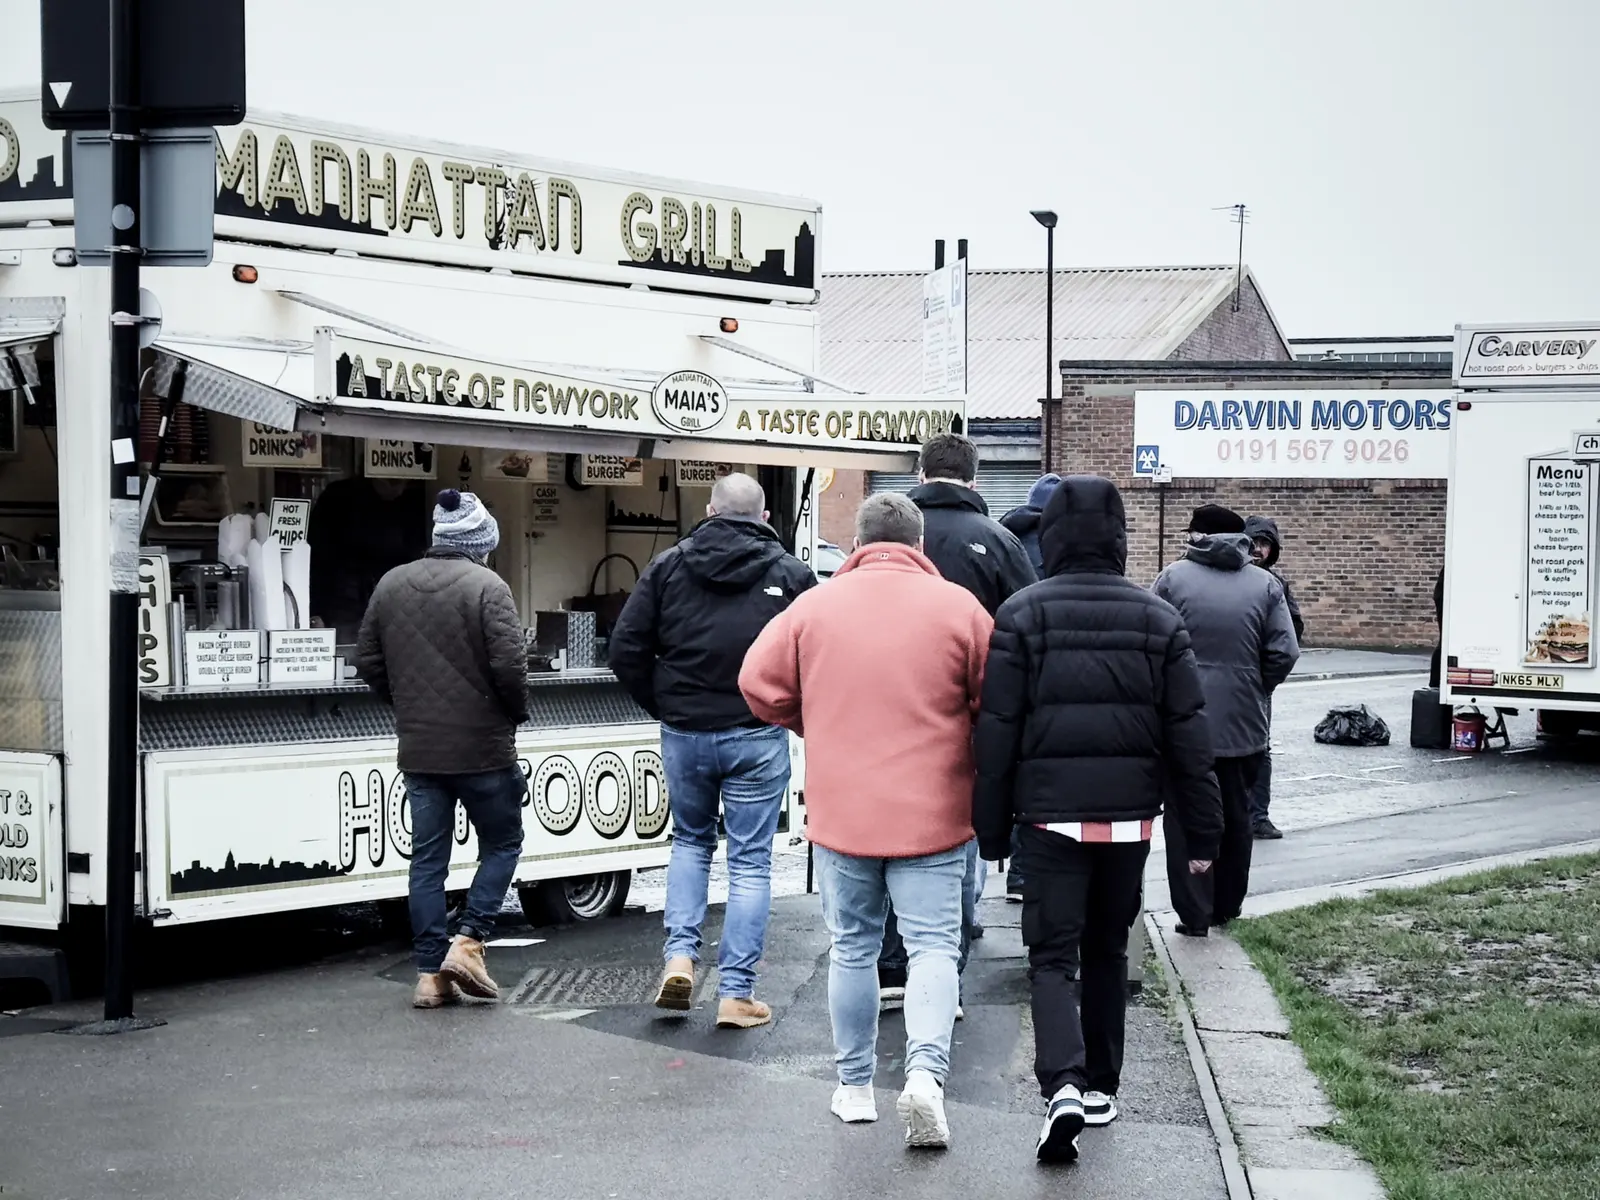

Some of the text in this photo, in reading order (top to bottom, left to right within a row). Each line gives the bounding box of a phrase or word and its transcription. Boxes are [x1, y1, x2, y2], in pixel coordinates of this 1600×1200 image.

[215, 129, 752, 273] MANHATTAN GRILL
[1478, 336, 1596, 359] CARVERY
[1536, 364, 1566, 373] burgers
[1577, 363, 1598, 371] chips
[348, 354, 640, 420] A TASTE OF NEWYORK
[672, 373, 712, 388] MANHATTAN
[664, 388, 719, 413] MAIA'S
[681, 416, 701, 428] GRILL
[1174, 400, 1451, 431] DARVIN MOTORS
[736, 411, 751, 431] A
[758, 409, 819, 437] TASTE
[825, 409, 853, 438] OF
[249, 438, 295, 456] DRINKS
[1217, 438, 1410, 463] 0191 567 9026
[372, 450, 414, 468] DRINKS
[587, 466, 625, 479] BURGER
[680, 468, 716, 481] BURGER
[1537, 466, 1583, 479] Menu
[536, 488, 556, 498] CASH
[1556, 490, 1582, 498] burgers
[282, 505, 299, 514] HOT
[278, 516, 301, 526] FRESH
[1558, 544, 1583, 552] burgers
[1531, 590, 1551, 598] jumbo
[139, 558, 159, 683] CHIPS
[1502, 674, 1560, 686] NK65 MLX
[16, 790, 32, 816] &
[0, 823, 28, 848] LD
